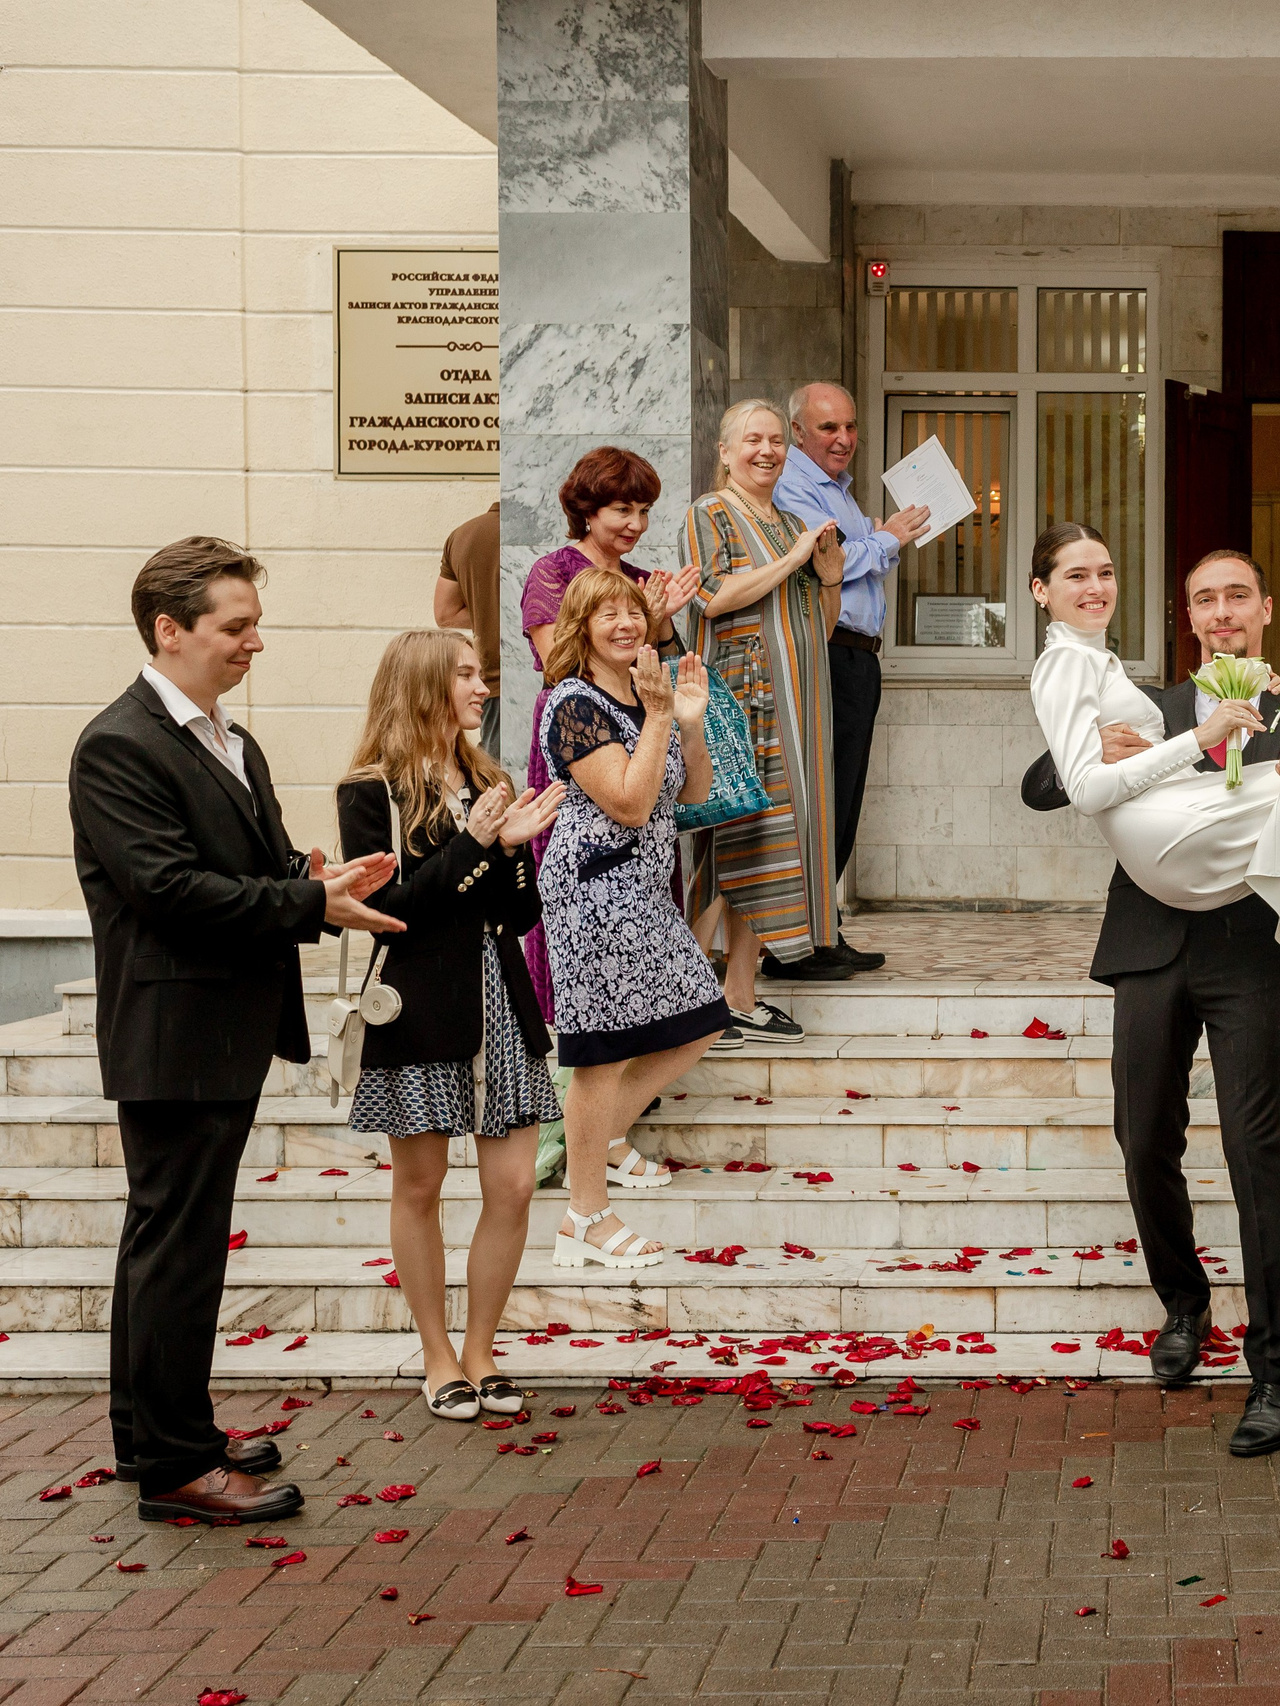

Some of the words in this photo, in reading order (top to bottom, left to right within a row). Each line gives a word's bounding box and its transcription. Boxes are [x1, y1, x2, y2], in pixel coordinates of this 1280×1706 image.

[392, 271, 470, 282] РОССИЙСКАЯ
[348, 302, 391, 310] ЗАПИСИ
[392, 302, 429, 310] АКТОВ
[440, 369, 492, 384] ОТДЕЛ
[404, 392, 471, 405] ЗАПИСИ
[349, 416, 480, 431] ГРАЖДАНСКОГО
[348, 439, 485, 454] ГОРОДА-КУРОРТА
[709, 705, 739, 720] STLE
[703, 710, 716, 744] fashio
[724, 768, 756, 786] STYLE
[708, 782, 747, 801] STYLE
